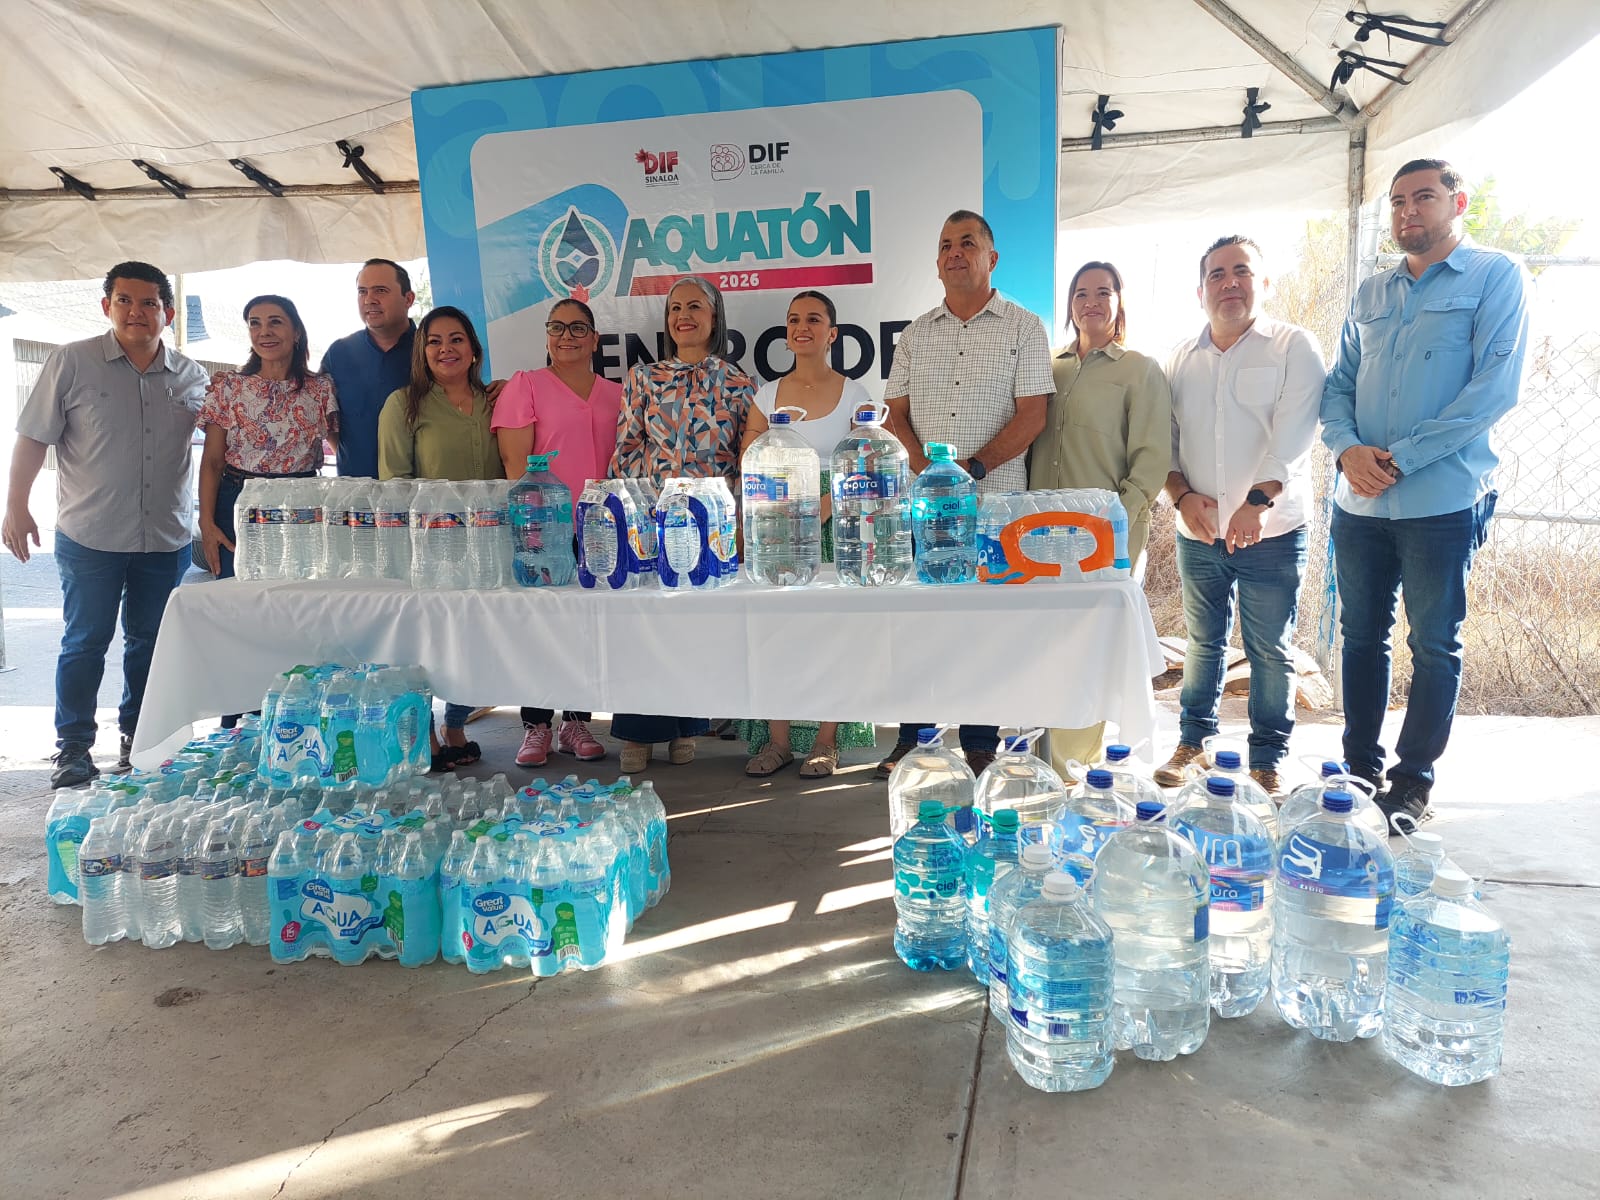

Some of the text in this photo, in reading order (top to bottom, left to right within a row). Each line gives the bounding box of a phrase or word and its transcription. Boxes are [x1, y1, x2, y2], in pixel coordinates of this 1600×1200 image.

[748, 142, 790, 163] DIF
[644, 151, 679, 175] DIF
[645, 174, 679, 184] SINALOA
[615, 190, 872, 297] AQUATÓN
[719, 273, 760, 288] 2026
[936, 879, 957, 892] ciel
[475, 896, 504, 908] Great
[482, 904, 504, 913] Value
[312, 902, 362, 927] AGUA
[483, 913, 534, 936] AGUA
